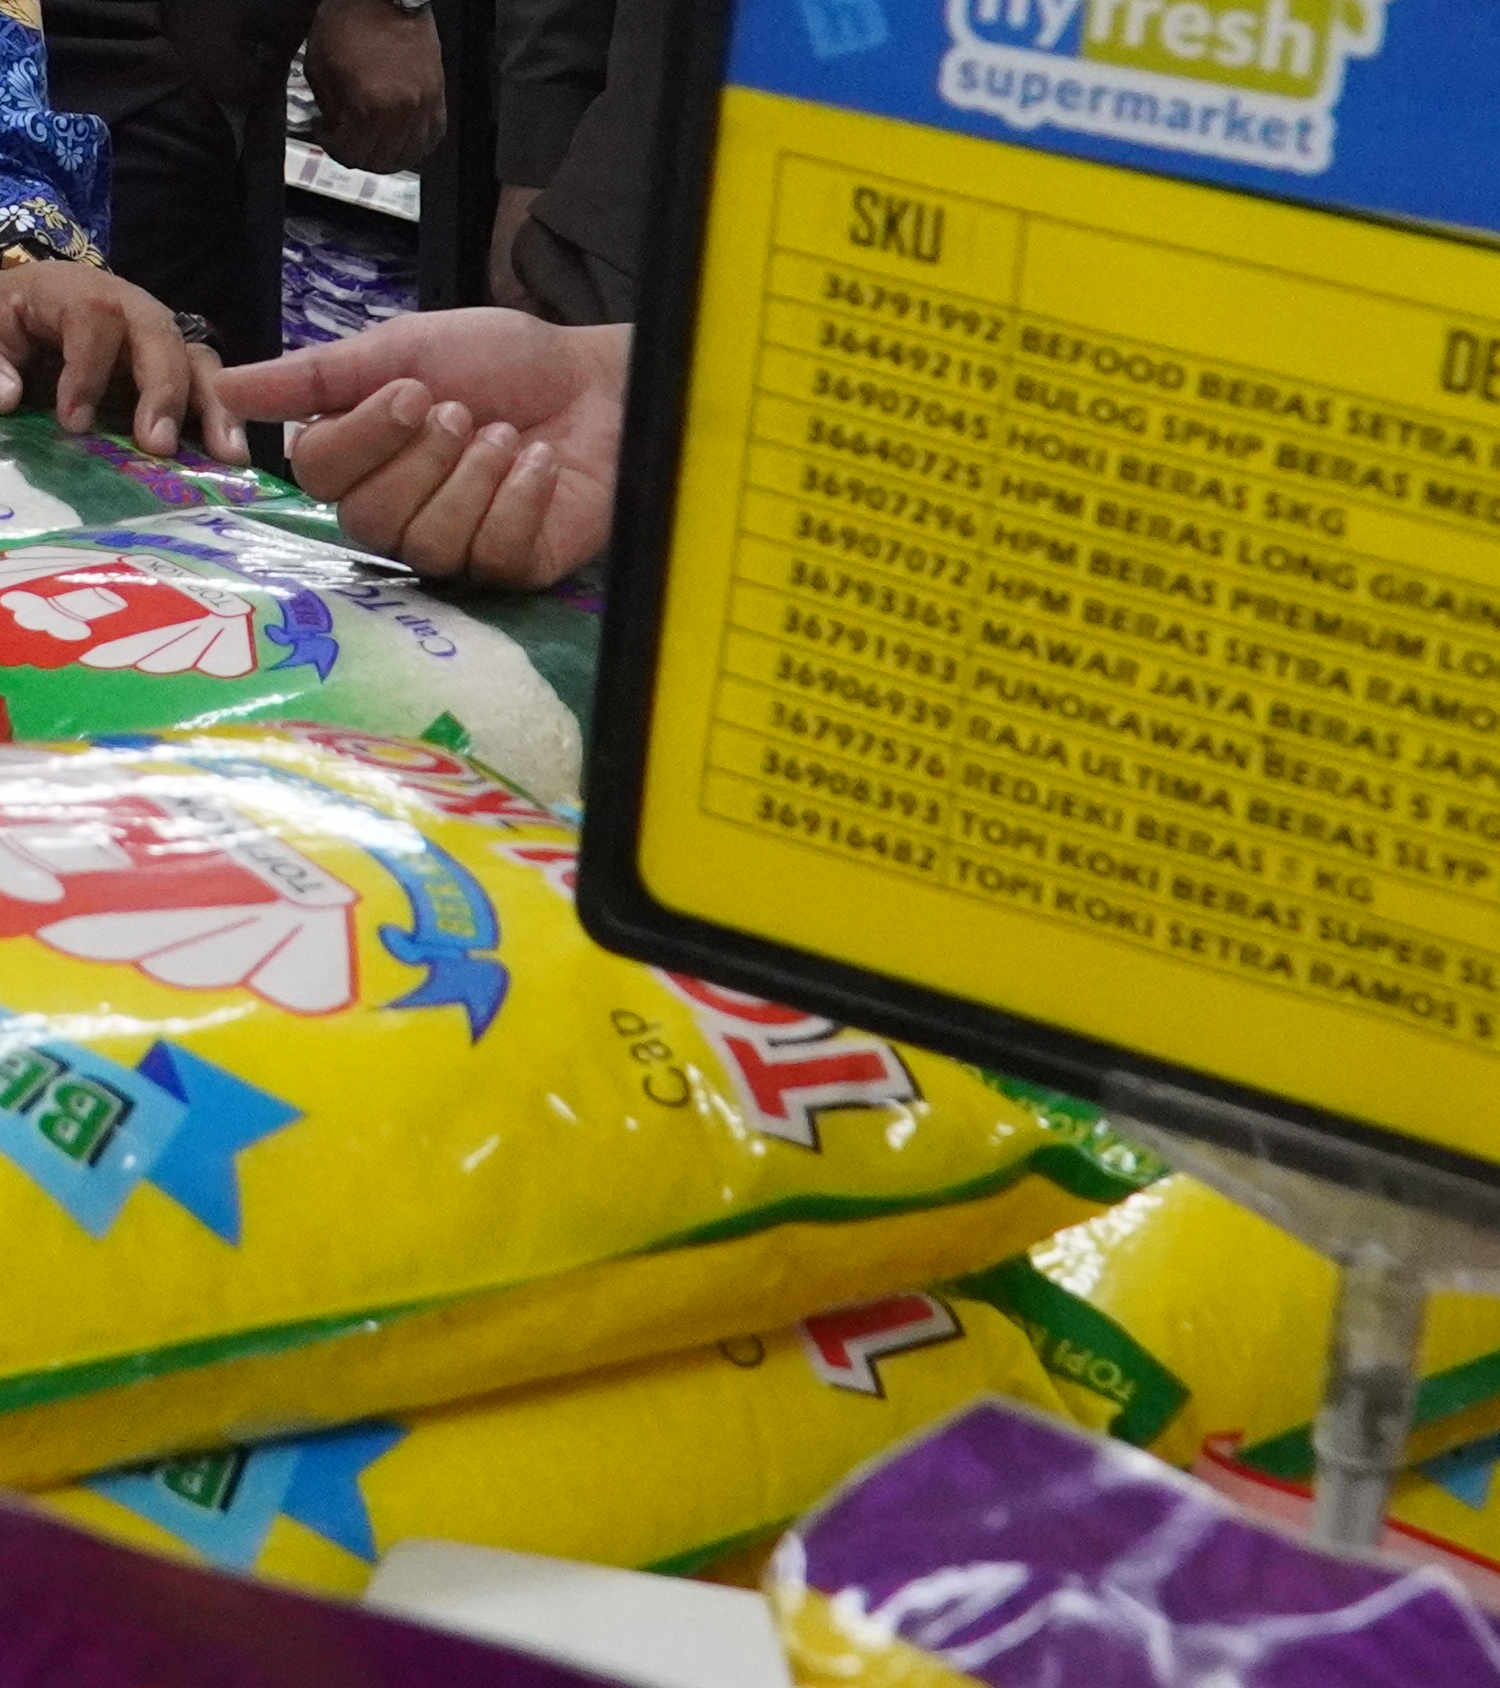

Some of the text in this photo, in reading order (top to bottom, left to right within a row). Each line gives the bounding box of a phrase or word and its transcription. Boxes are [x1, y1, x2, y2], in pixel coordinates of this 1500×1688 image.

[953, 53, 1315, 157] supermarket
[849, 185, 945, 266] SKU
[1012, 375, 1147, 435] BULOG
[1162, 414, 1264, 458] SPHP
[1274, 442, 1408, 501] BERAS
[1018, 324, 1187, 391] BEFOOD
[1196, 371, 1331, 427] BERAS
[1346, 406, 1477, 462] SETRA
[1005, 426, 1106, 473] HOKI
[1117, 456, 1247, 512] BERAS
[991, 524, 1078, 566] HPM
[1087, 550, 1216, 607] BERAS
[998, 475, 1085, 517] HPM
[1094, 500, 1224, 558] BERAS
[1236, 539, 1356, 593] LONG
[400, 612, 459, 660] Cap
[979, 619, 1138, 684] MAWAR
[1149, 674, 1254, 719] JAYA
[1267, 701, 1400, 762] BERAS
[985, 572, 1071, 614] HPM
[1081, 599, 1209, 658] BERAS
[1225, 637, 1352, 695] SETRA
[967, 715, 1068, 767] RAJA
[1245, 798, 1378, 860] BERAS
[973, 667, 1248, 770] PUNOKAWAN
[1261, 743, 1394, 813] BERAS
[961, 763, 1123, 830] REDJEKI
[1133, 815, 1264, 875] BERAS
[956, 856, 1043, 904] TOPI
[1053, 888, 1155, 938] KOKI
[1168, 922, 1295, 978] SETRA
[1308, 961, 1457, 1028] RAMOS
[960, 808, 1047, 858] TOPI
[1056, 842, 1159, 891] KOKI
[1170, 875, 1302, 933] BERAS
[1317, 914, 1447, 973] SUPER
[608, 1007, 696, 1111] Cap
